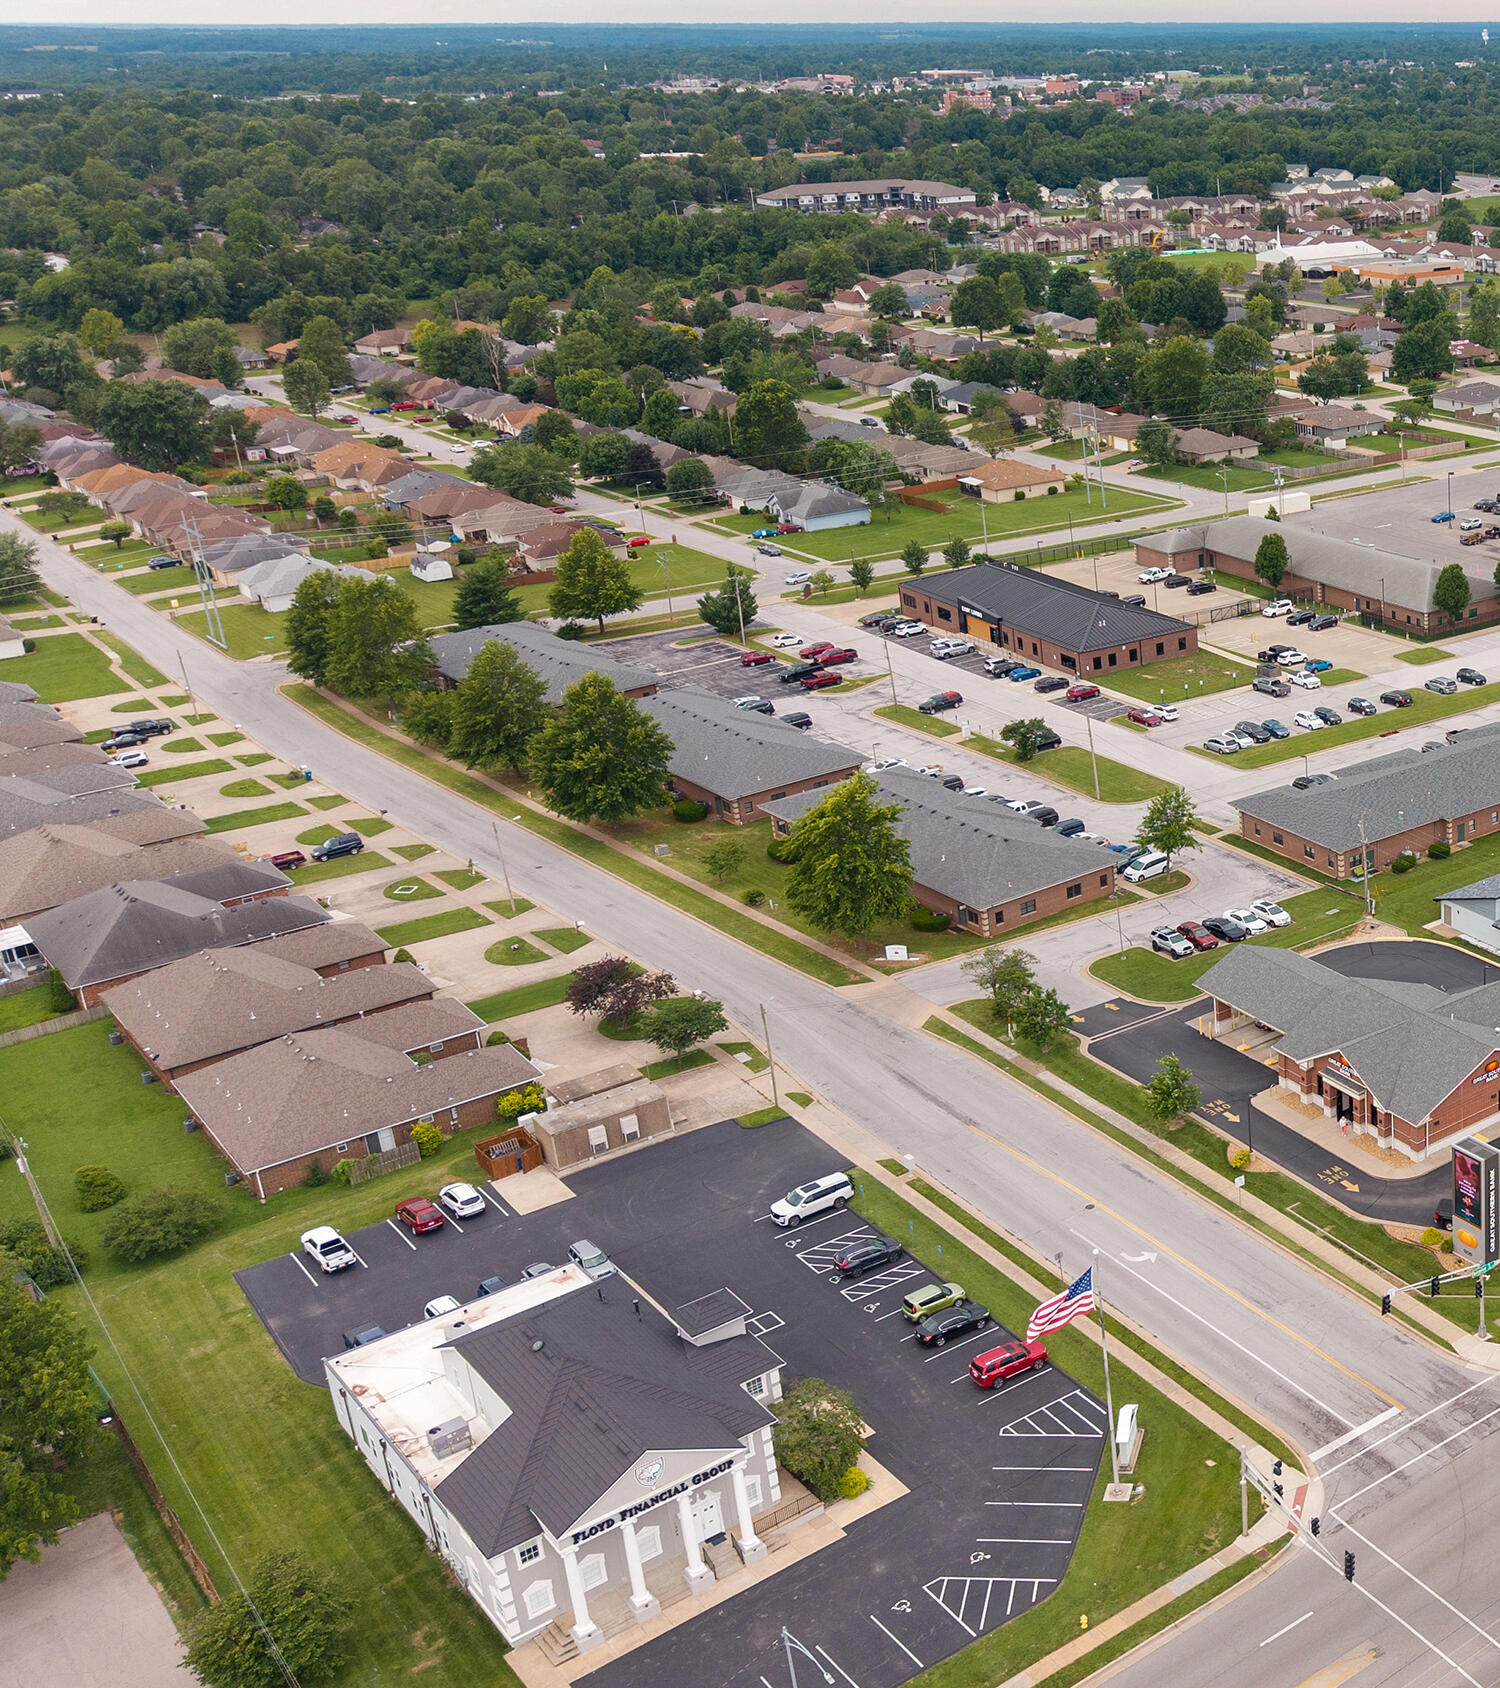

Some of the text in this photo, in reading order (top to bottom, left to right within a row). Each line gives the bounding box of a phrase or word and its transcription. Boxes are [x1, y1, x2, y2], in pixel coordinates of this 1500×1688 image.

[1472, 1072, 1488, 1084] GREAT
[1317, 1165, 1342, 1180] WAY
[1323, 1170, 1349, 1184] ONE
[571, 1459, 734, 1545] FLOYD FINANCIAL GROUP
